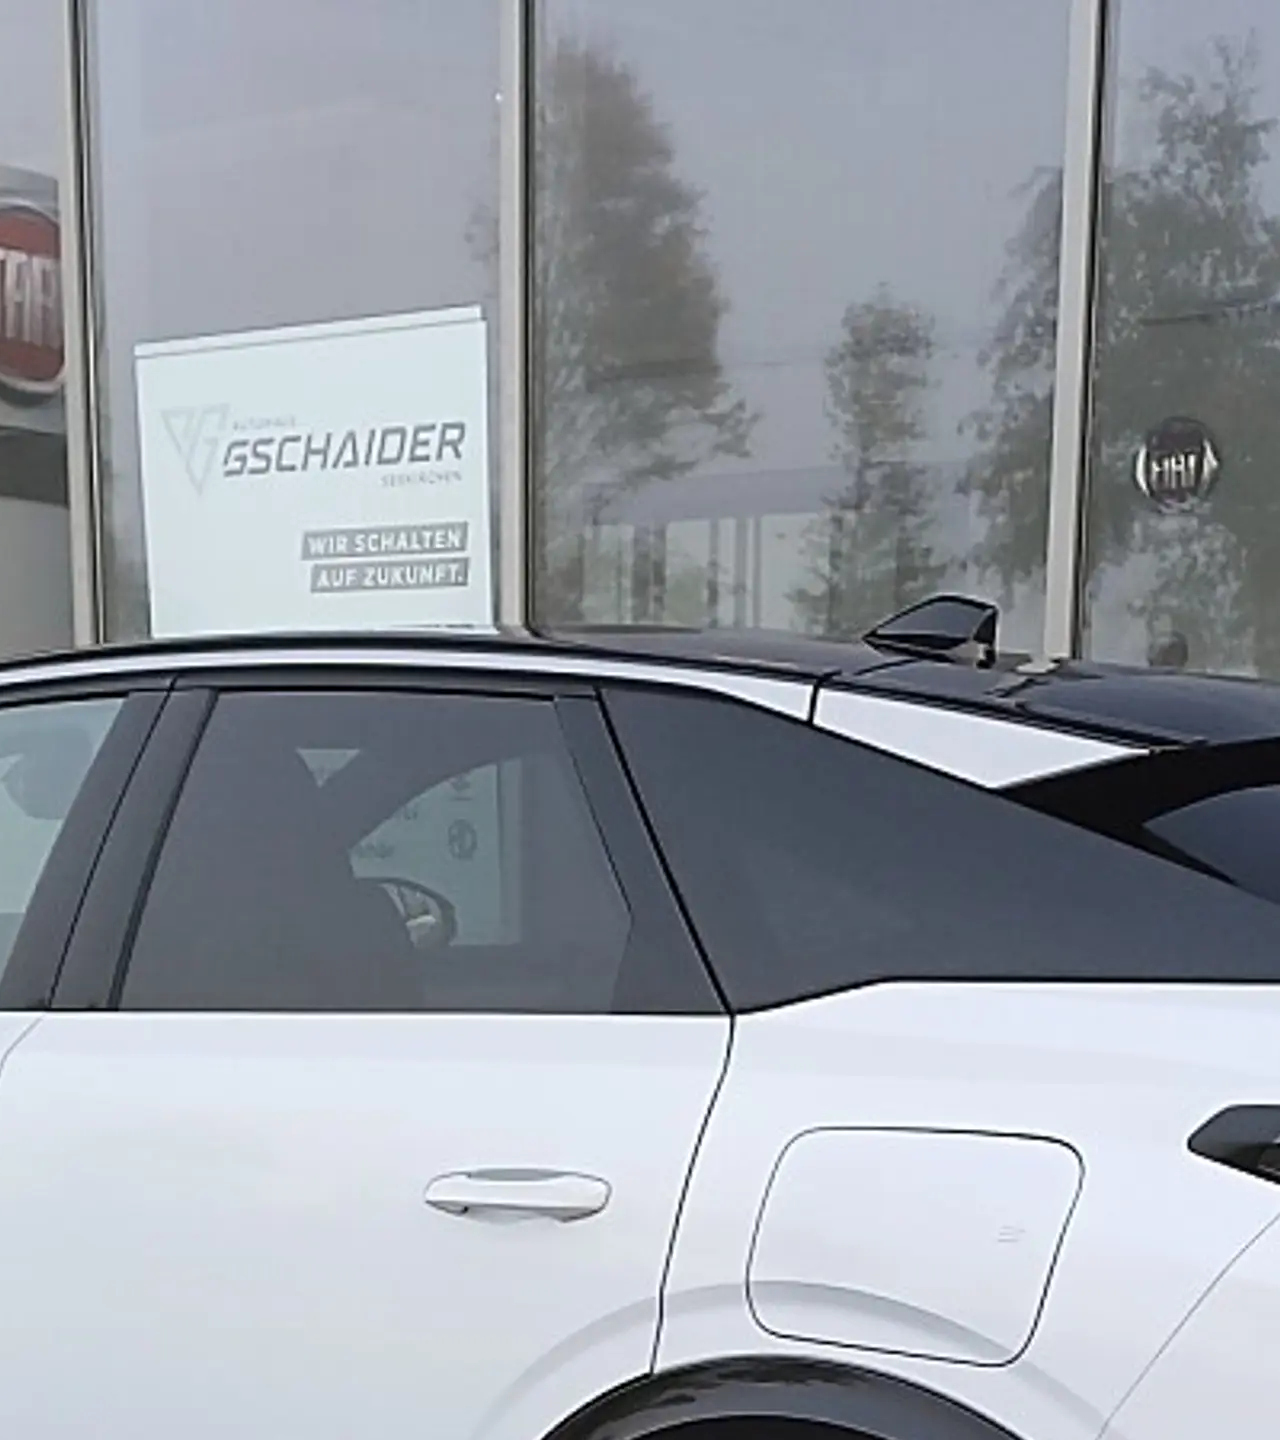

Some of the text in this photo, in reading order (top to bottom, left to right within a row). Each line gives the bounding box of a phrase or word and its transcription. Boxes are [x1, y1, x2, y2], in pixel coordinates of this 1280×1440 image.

[222, 421, 467, 478] GSCHAIDER
[306, 528, 462, 556] WIR SCHALTEN
[316, 563, 464, 588] AUF ZUKUNFT.
